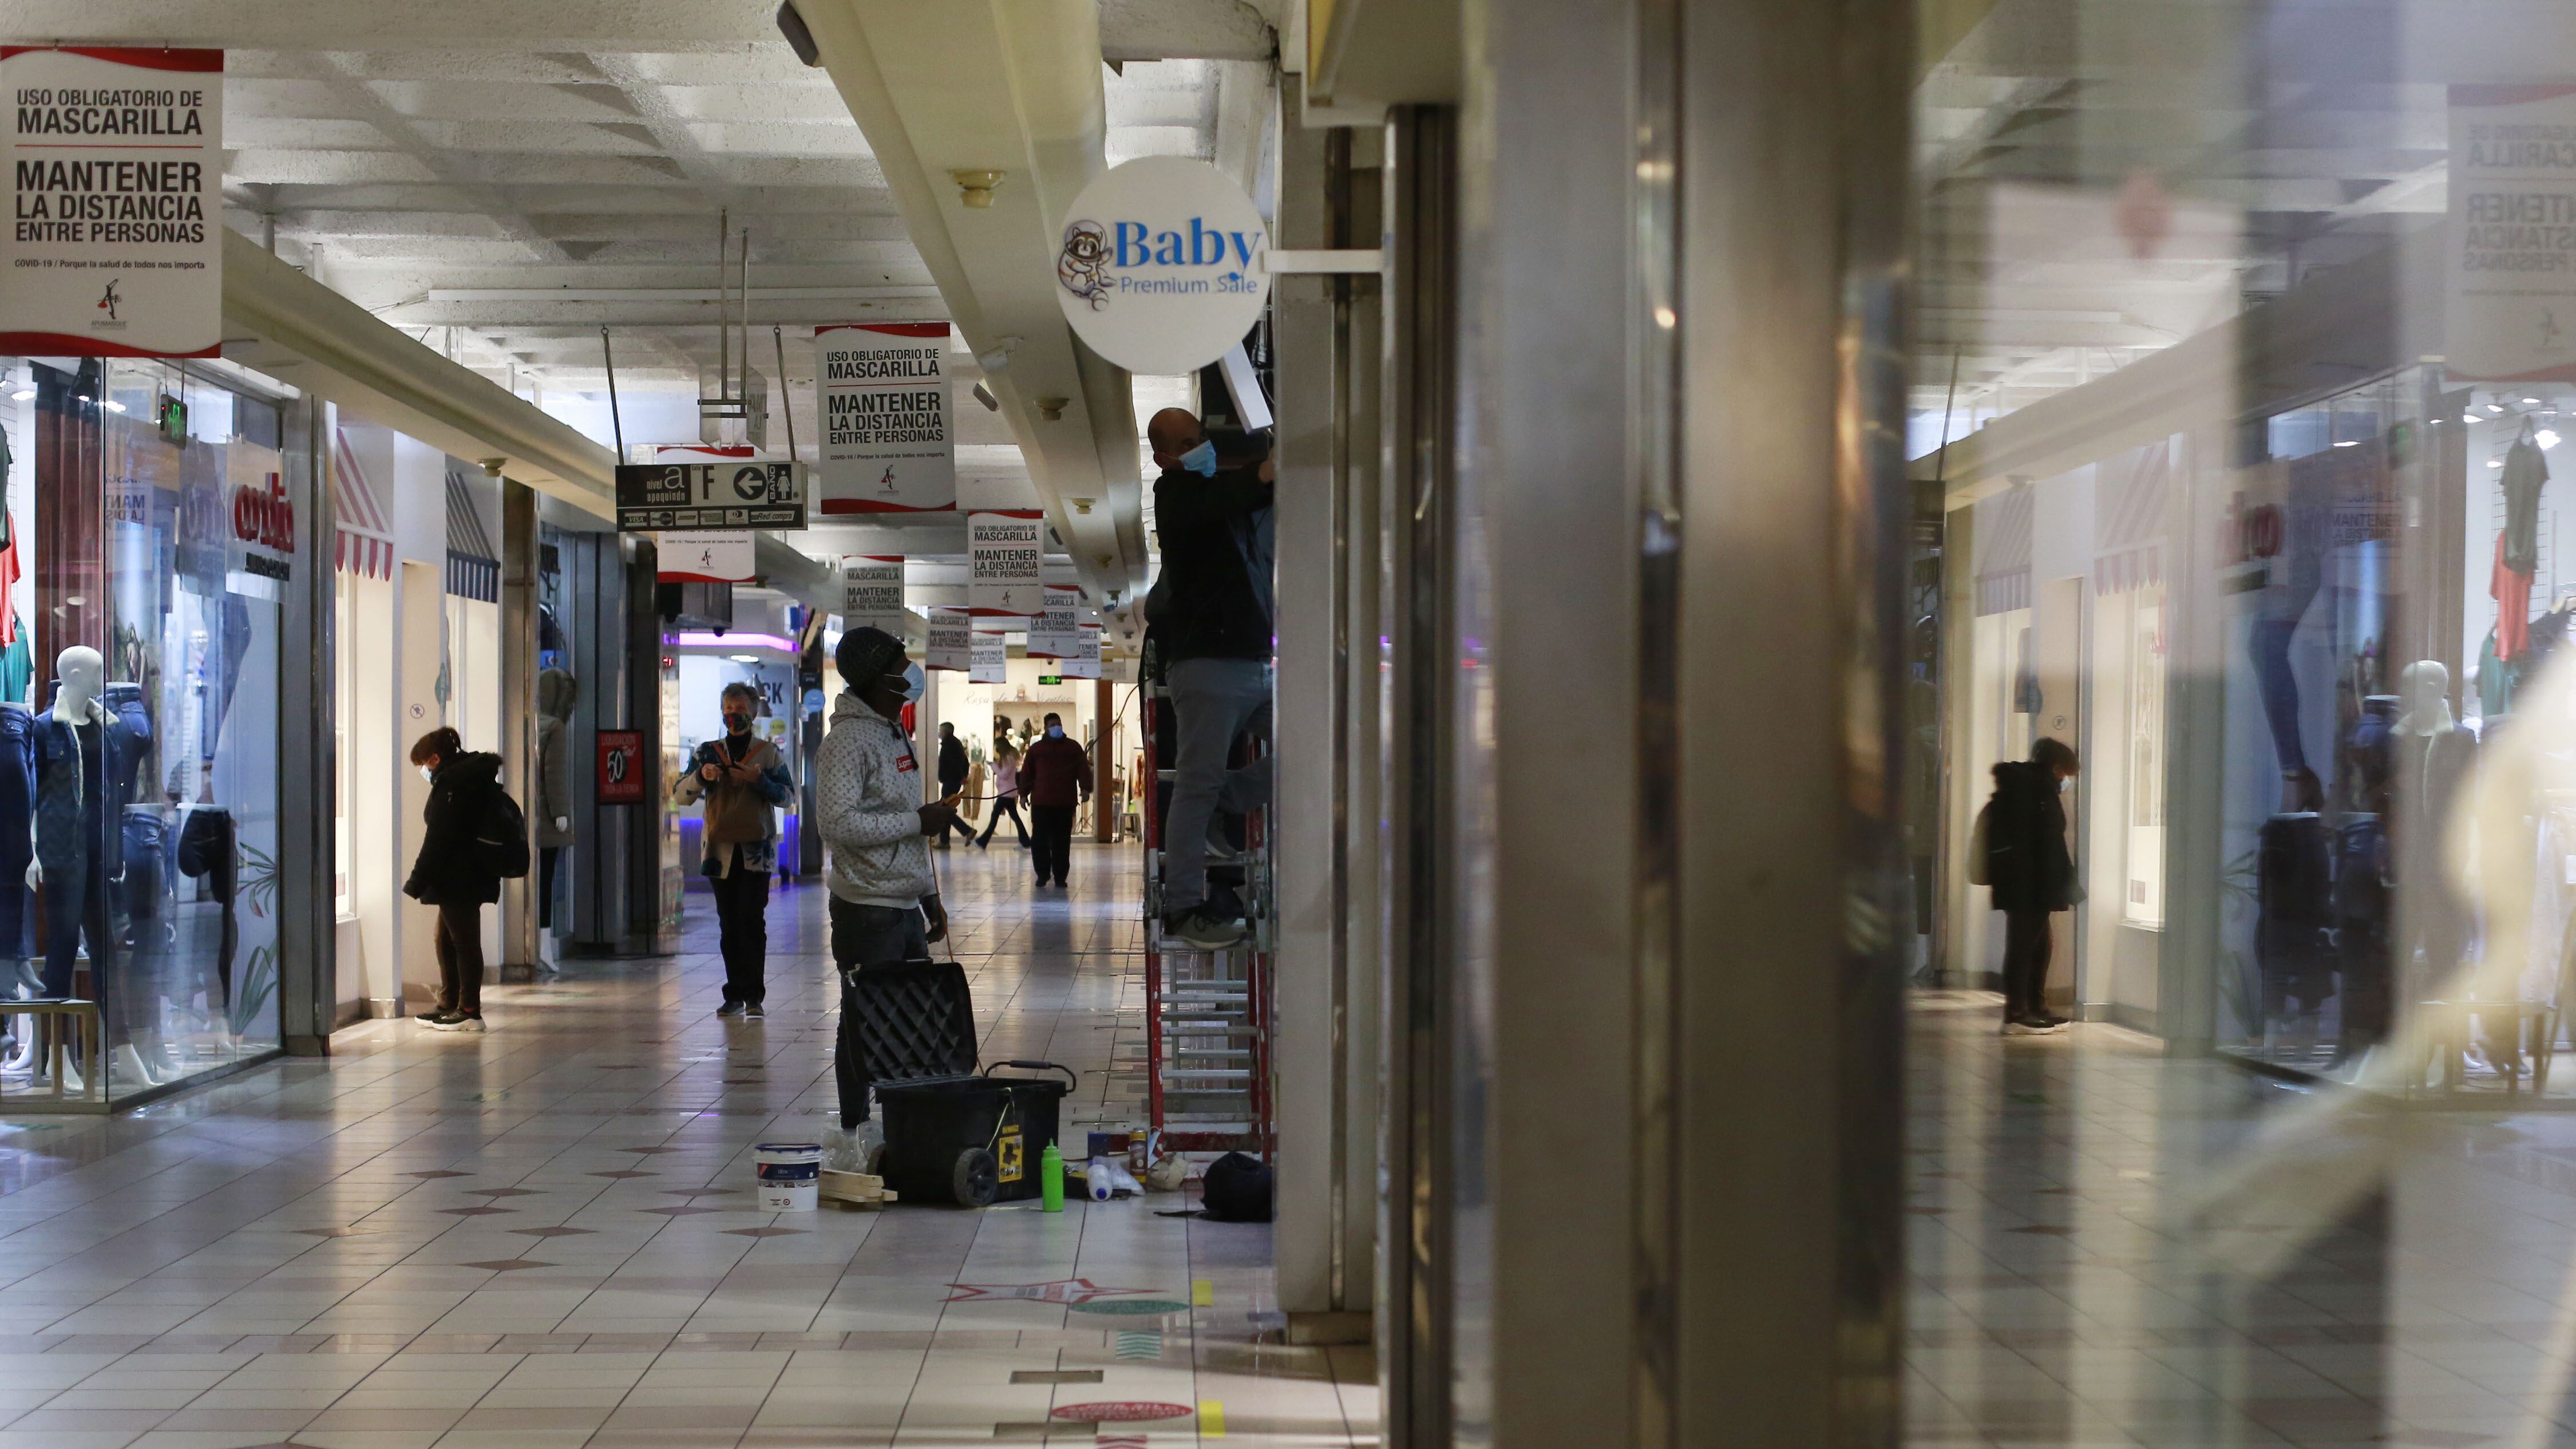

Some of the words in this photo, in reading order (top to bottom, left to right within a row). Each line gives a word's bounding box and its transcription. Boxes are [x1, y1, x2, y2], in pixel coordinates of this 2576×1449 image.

[17, 89, 52, 106] USO
[58, 89, 173, 107] OBLIGATORIO
[180, 90, 203, 107] DE
[17, 108, 203, 135] MASCARILLA
[16, 160, 201, 192] MANTENER
[15, 194, 50, 219] LA
[59, 195, 203, 221] DISTANCIA
[15, 222, 83, 242] ENTRE
[91, 222, 204, 243] PERSONAS
[1114, 216, 1262, 281] Baby
[14, 259, 52, 268] COVID-19
[60, 260, 87, 270] Porque
[98, 260, 120, 269] salud
[122, 260, 132, 269] de
[134, 260, 156, 269] todos
[174, 260, 205, 271] importa
[1121, 276, 1208, 293] Premium
[1217, 275, 1257, 293] Sale
[827, 351, 848, 362] USO
[852, 349, 922, 362] OBLIGATORIO
[925, 349, 939, 358] DE
[828, 360, 940, 379] MASCARILLA
[829, 392, 941, 414] MANTENER
[829, 415, 850, 431] LA
[856, 413, 943, 430] DISTANCIA
[830, 431, 871, 445] ENTRE
[875, 429, 944, 443] PERSONAS
[646, 479, 662, 489] nivel
[664, 466, 684, 489] a
[703, 465, 714, 500] F
[647, 491, 685, 503] apoquindo
[975, 531, 1037, 541] MASCARILLA
[975, 550, 1037, 560] MANTENER
[975, 562, 986, 570] LA
[990, 561, 1038, 570] DISTANCIA
[847, 572, 899, 580] MASCARILLA
[847, 587, 899, 596] MANTENER
[848, 596, 857, 604] LA
[860, 596, 899, 604] DISTANCIA
[607, 750, 623, 783] 50
